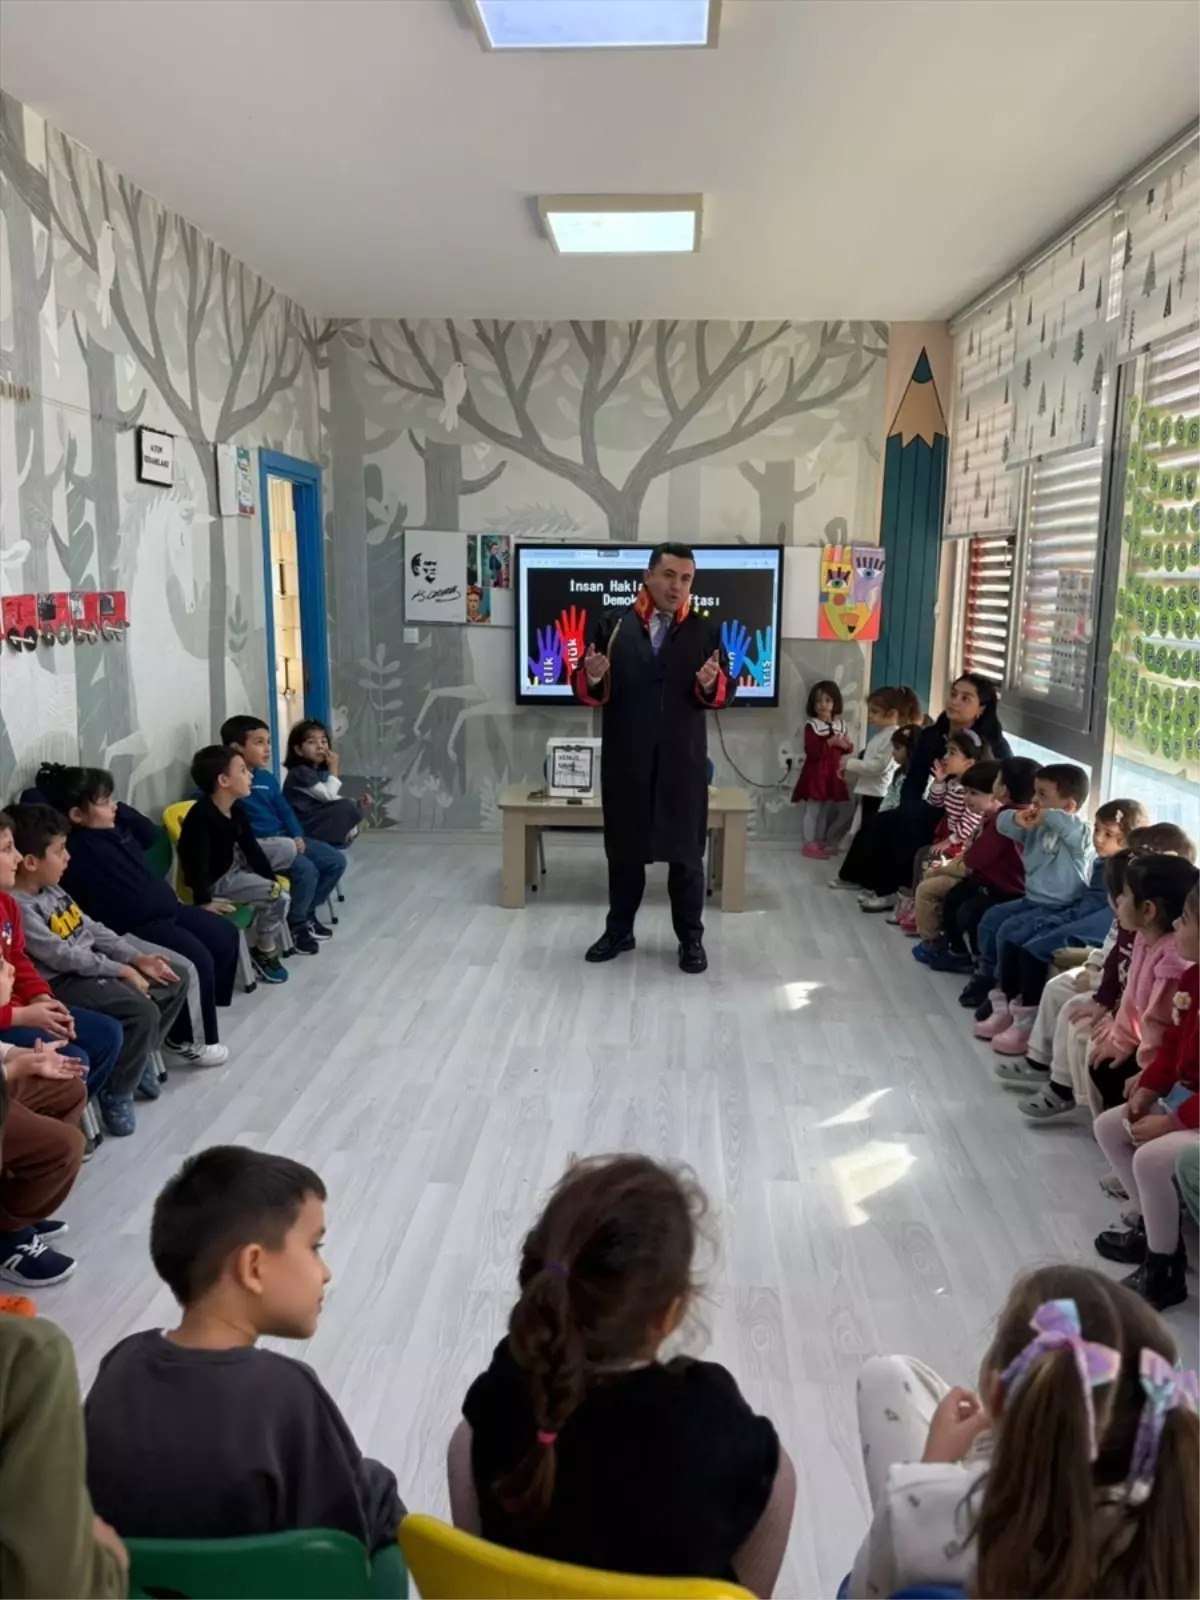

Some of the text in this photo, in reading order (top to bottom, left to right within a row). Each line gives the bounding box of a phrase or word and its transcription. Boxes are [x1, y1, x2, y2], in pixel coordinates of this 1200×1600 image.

[570, 579, 604, 592] İnsan
[603, 594, 638, 606] Demok
[567, 638, 578, 669] rlük
